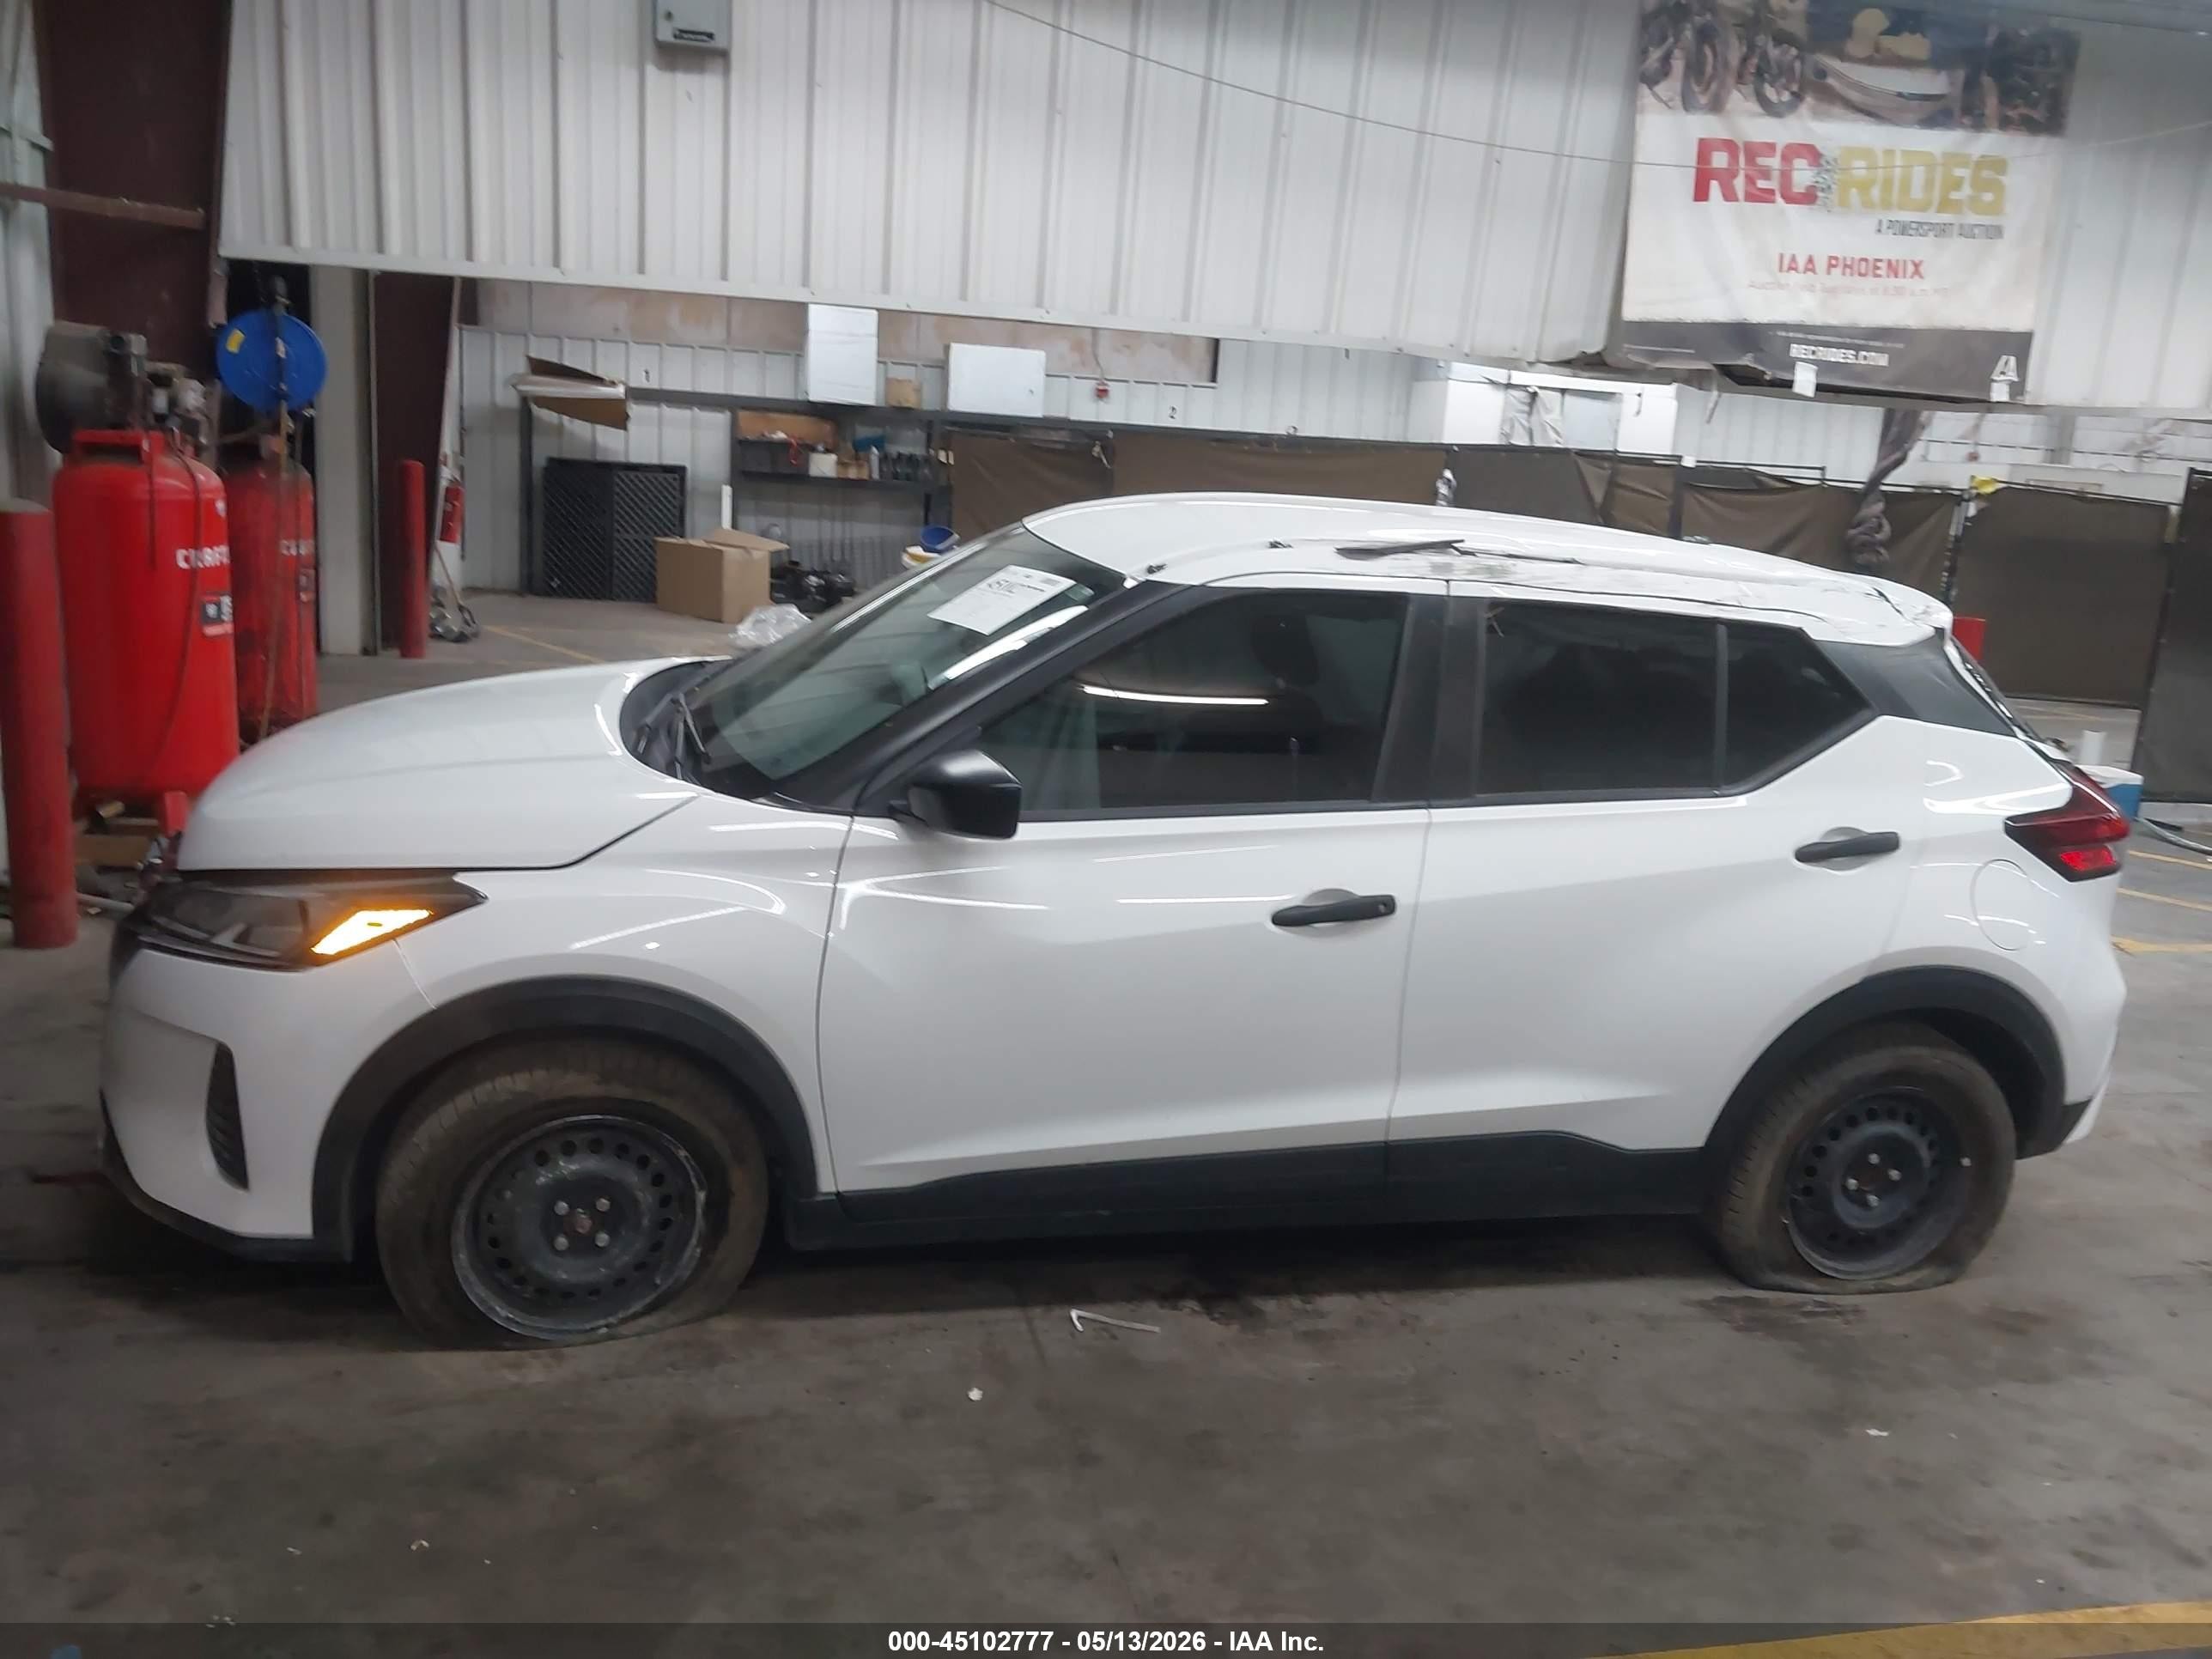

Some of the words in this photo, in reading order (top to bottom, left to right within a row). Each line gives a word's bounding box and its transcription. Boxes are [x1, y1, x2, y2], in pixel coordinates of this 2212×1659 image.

[1692, 137, 1822, 205] REC
[1836, 145, 2008, 215] RIDES
[1886, 219, 1954, 238] POWERSPORT
[1778, 252, 1817, 275] IAA
[1826, 255, 1924, 279] PHOENIX
[1790, 343, 1889, 367] RECRIDES.COM
